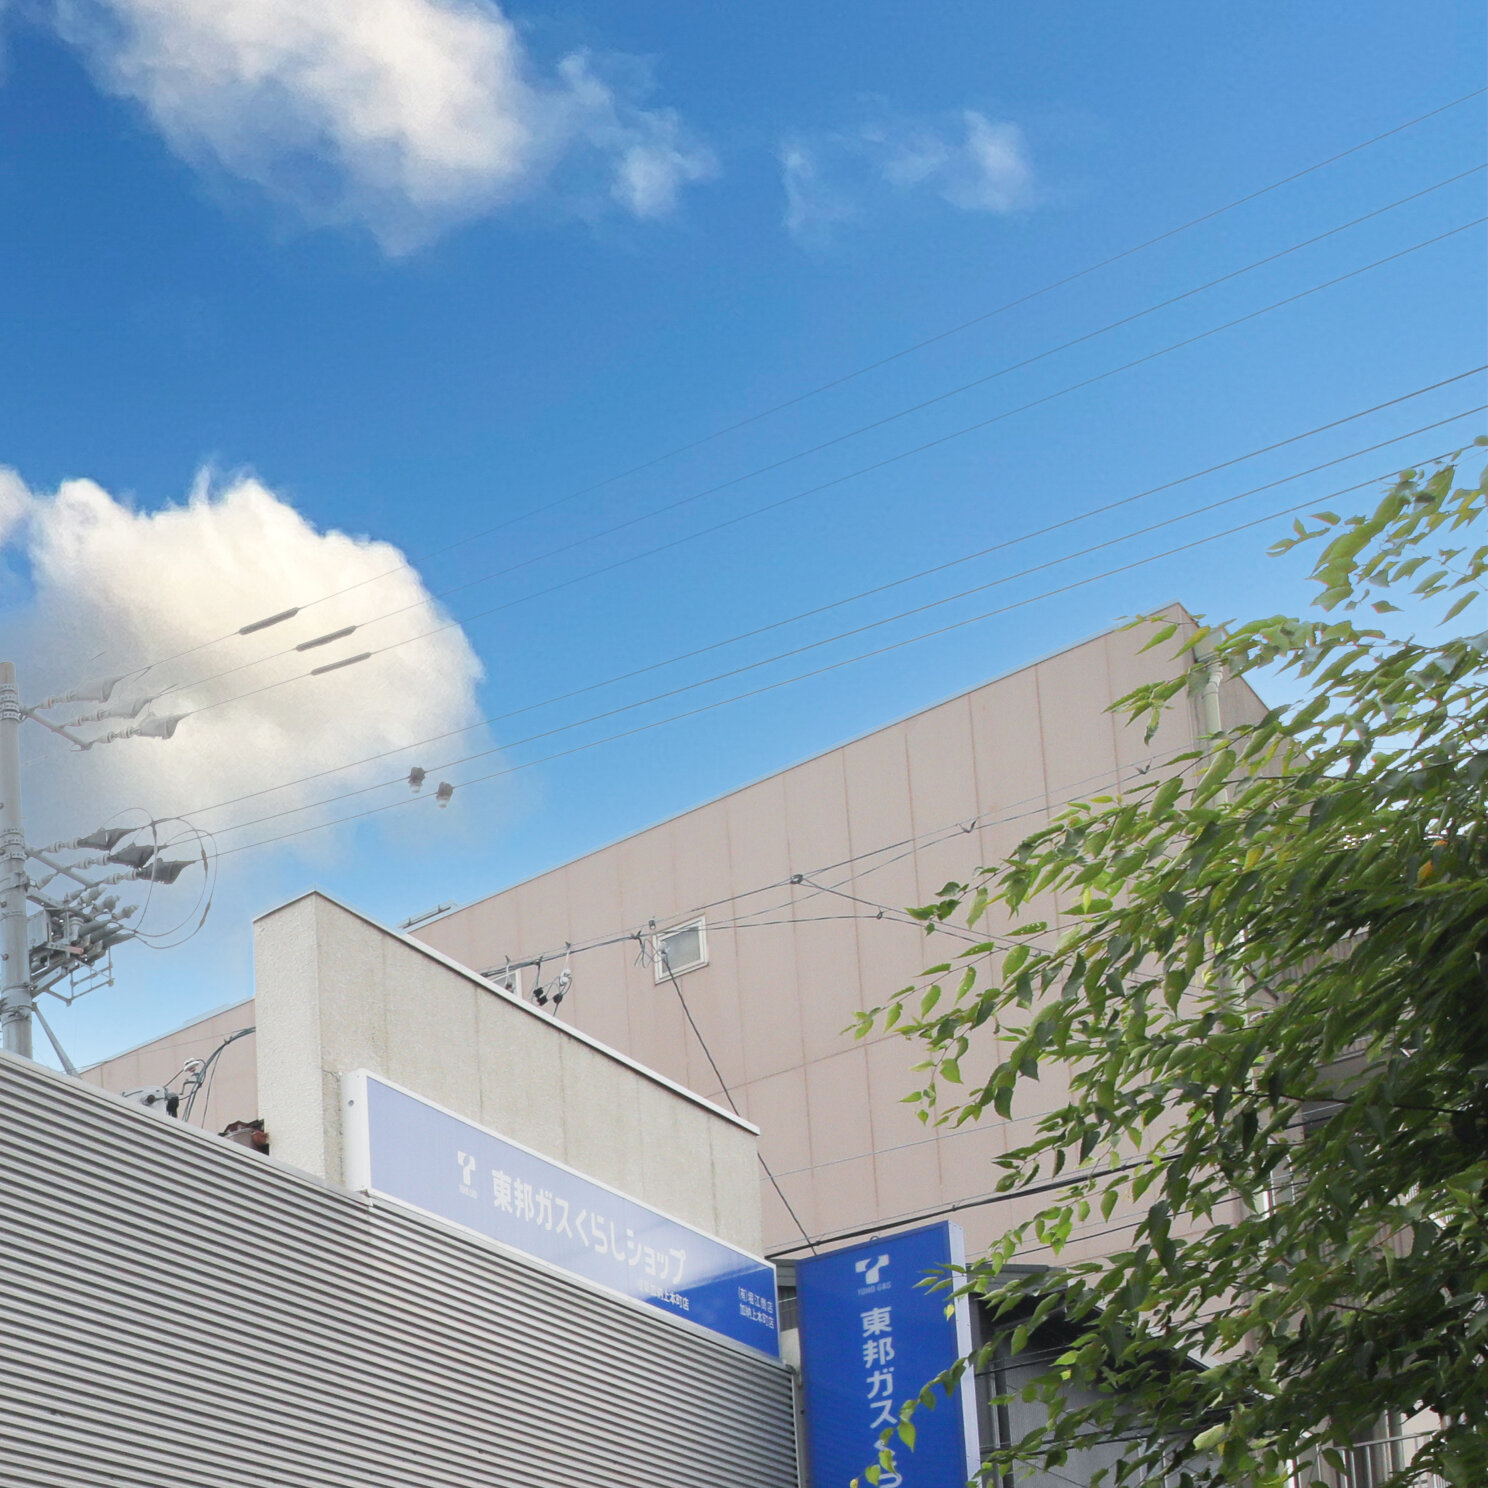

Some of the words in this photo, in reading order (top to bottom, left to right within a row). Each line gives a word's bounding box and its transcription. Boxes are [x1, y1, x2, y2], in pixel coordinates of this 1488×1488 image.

[491, 1169, 686, 1284] 東邦ガスくらしショップ
